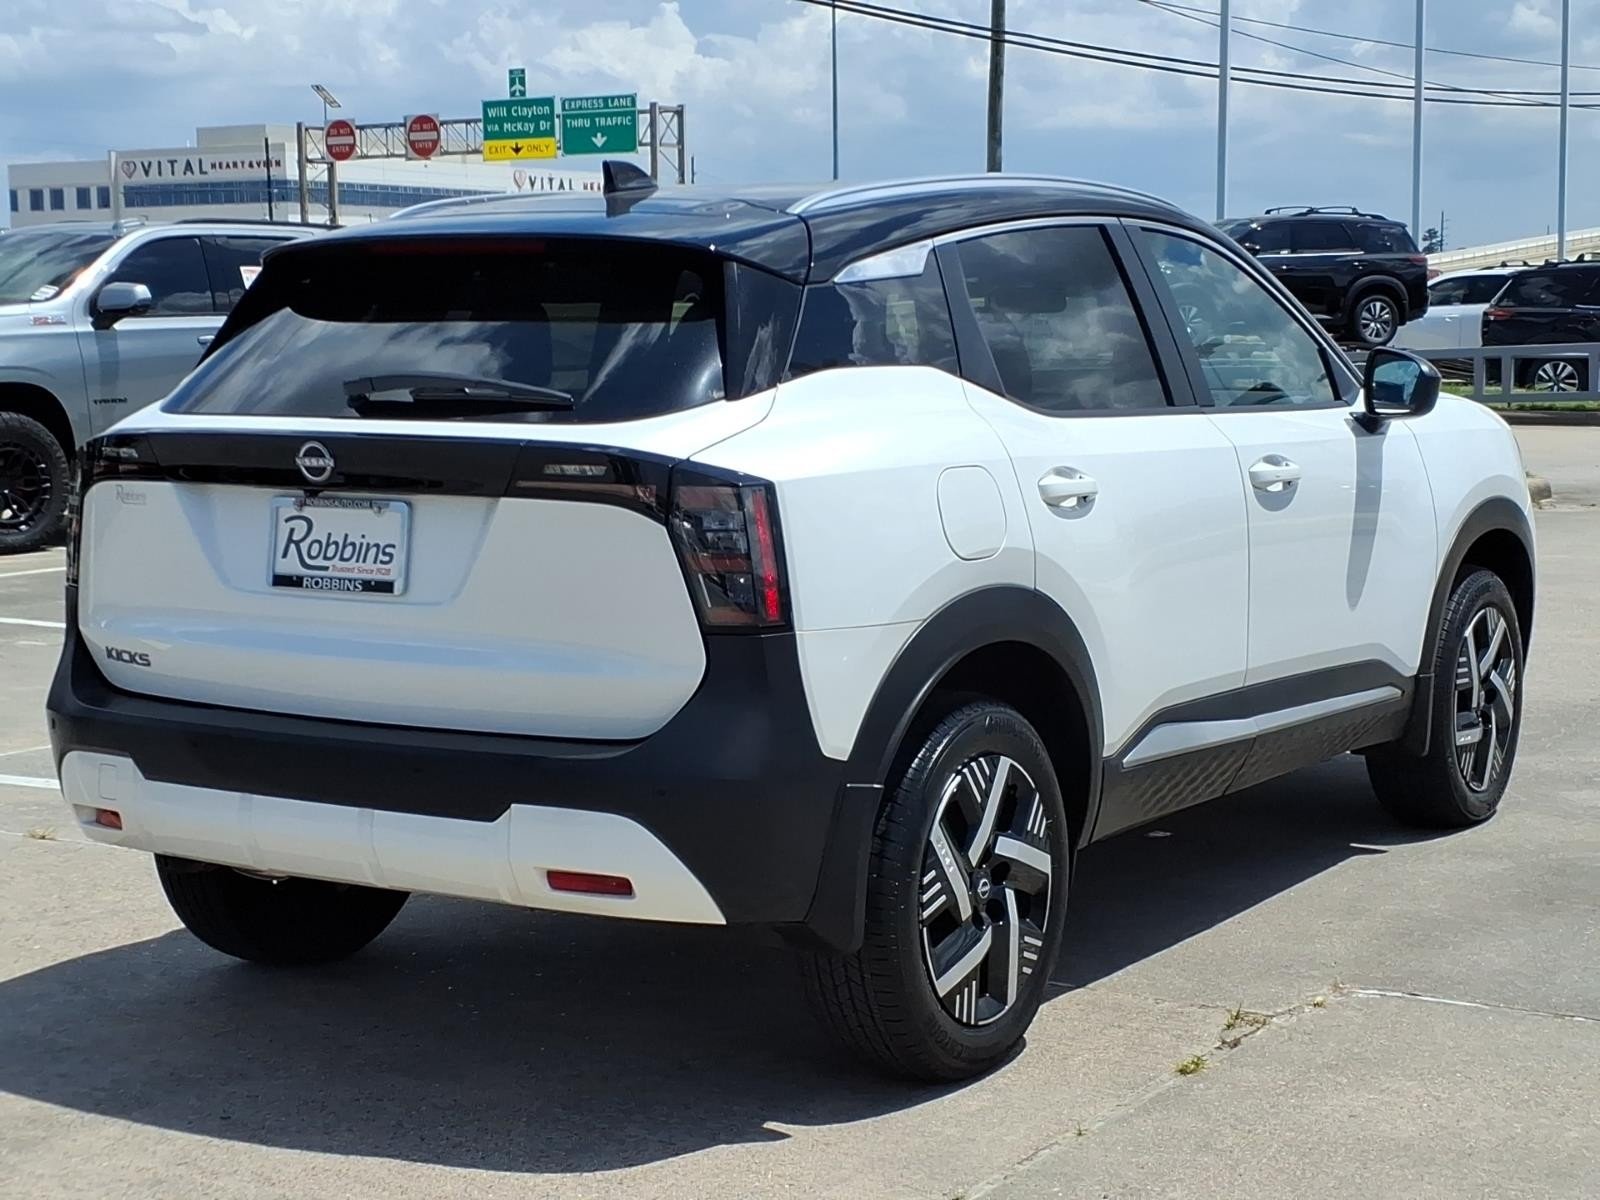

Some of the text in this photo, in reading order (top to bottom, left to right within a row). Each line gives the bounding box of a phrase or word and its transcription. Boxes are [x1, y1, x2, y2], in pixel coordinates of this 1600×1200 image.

[565, 96, 633, 110] EXPRESS LANE
[487, 105, 550, 119] Will Clayton
[486, 120, 551, 134] VIA McKay Dr
[566, 116, 633, 128] THRU TRAFFIC
[488, 143, 551, 155] EXIT ONLY
[140, 157, 208, 178] VITAL
[528, 175, 575, 191] VITAL
[281, 514, 396, 572] Robbins
[303, 576, 363, 592] ROBBINS
[105, 646, 151, 667] KICKS
